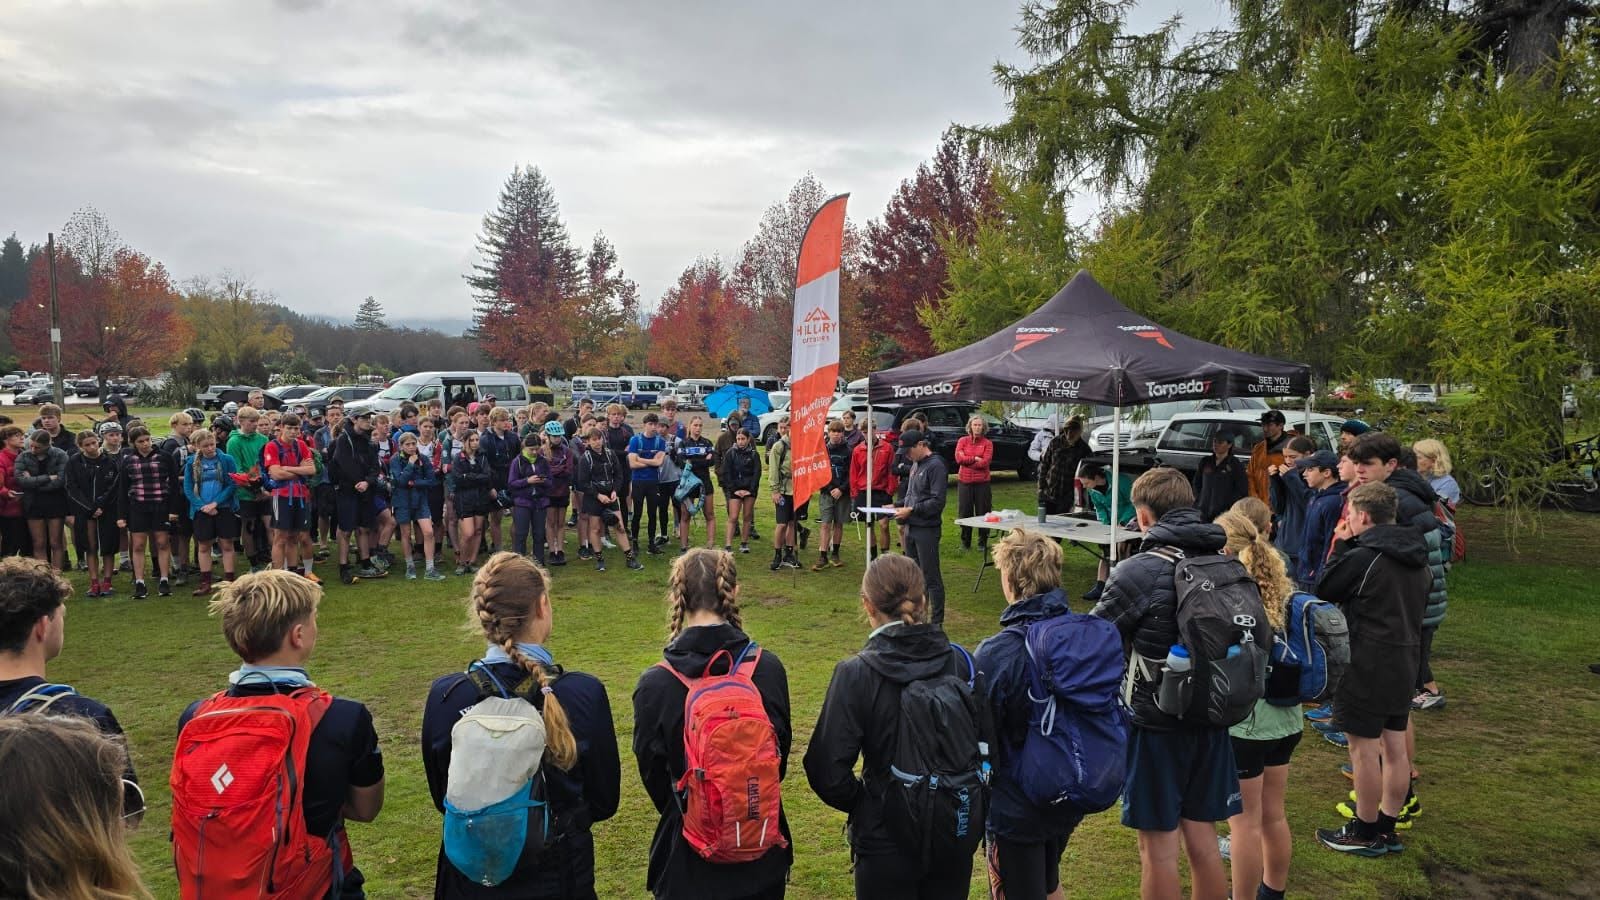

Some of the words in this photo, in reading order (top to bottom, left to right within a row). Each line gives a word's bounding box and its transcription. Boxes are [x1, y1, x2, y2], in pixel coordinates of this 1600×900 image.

[1026, 378, 1051, 389] SEE
[1055, 379, 1081, 390] YOU
[1258, 375, 1273, 385] SEE
[1274, 376, 1290, 386] YOU
[892, 380, 961, 399] Torpedo7
[1011, 385, 1037, 396] OUT
[1038, 387, 1080, 399] THERE
[1145, 378, 1212, 399] Torpedo7
[1248, 384, 1264, 393] OUT
[1266, 384, 1290, 394] THERE
